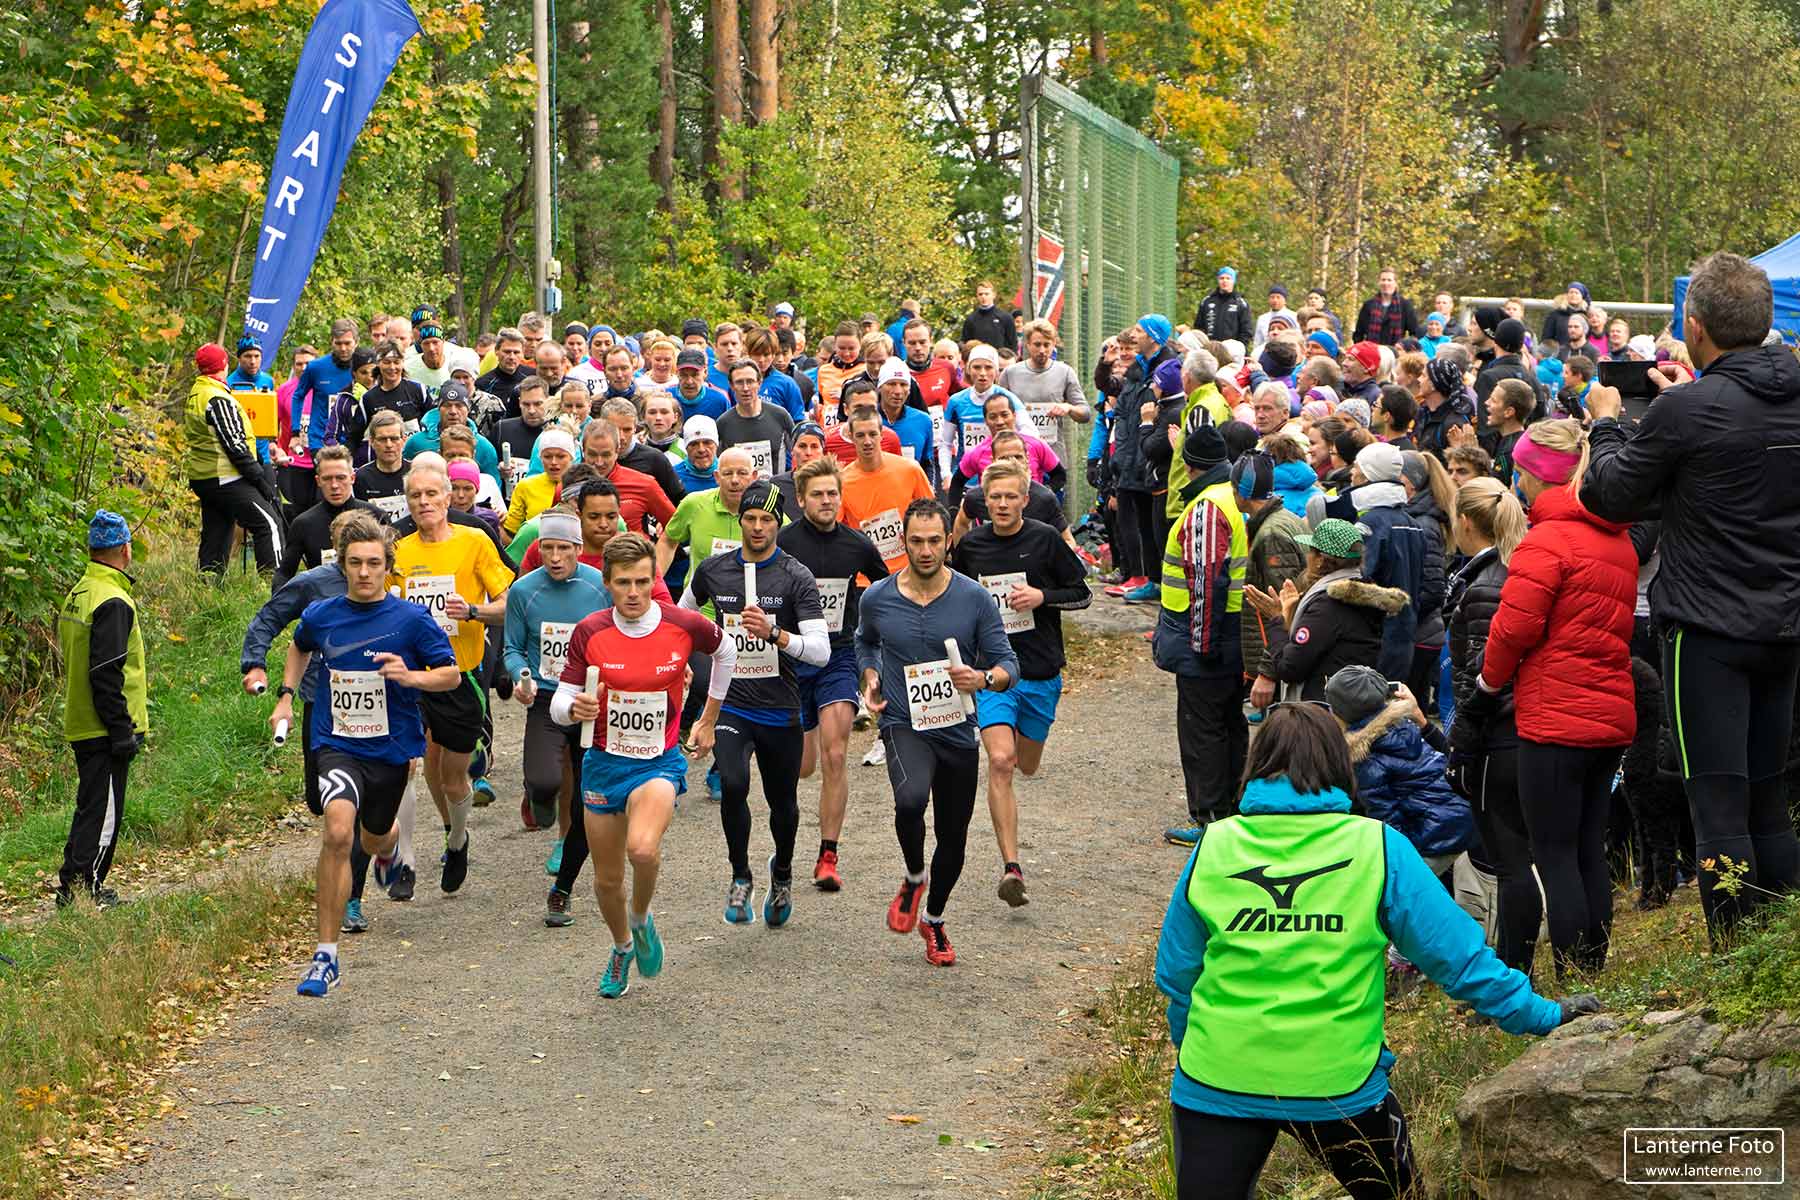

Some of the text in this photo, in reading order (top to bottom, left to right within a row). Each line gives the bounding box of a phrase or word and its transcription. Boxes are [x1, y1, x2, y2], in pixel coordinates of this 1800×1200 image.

[256, 32, 362, 261] START
[655, 664, 678, 676] pwc
[333, 688, 384, 710] 2075 M
[910, 680, 953, 704] 2043
[609, 709, 655, 732] 2006
[917, 710, 961, 729] phonero
[610, 740, 660, 755] phonero
